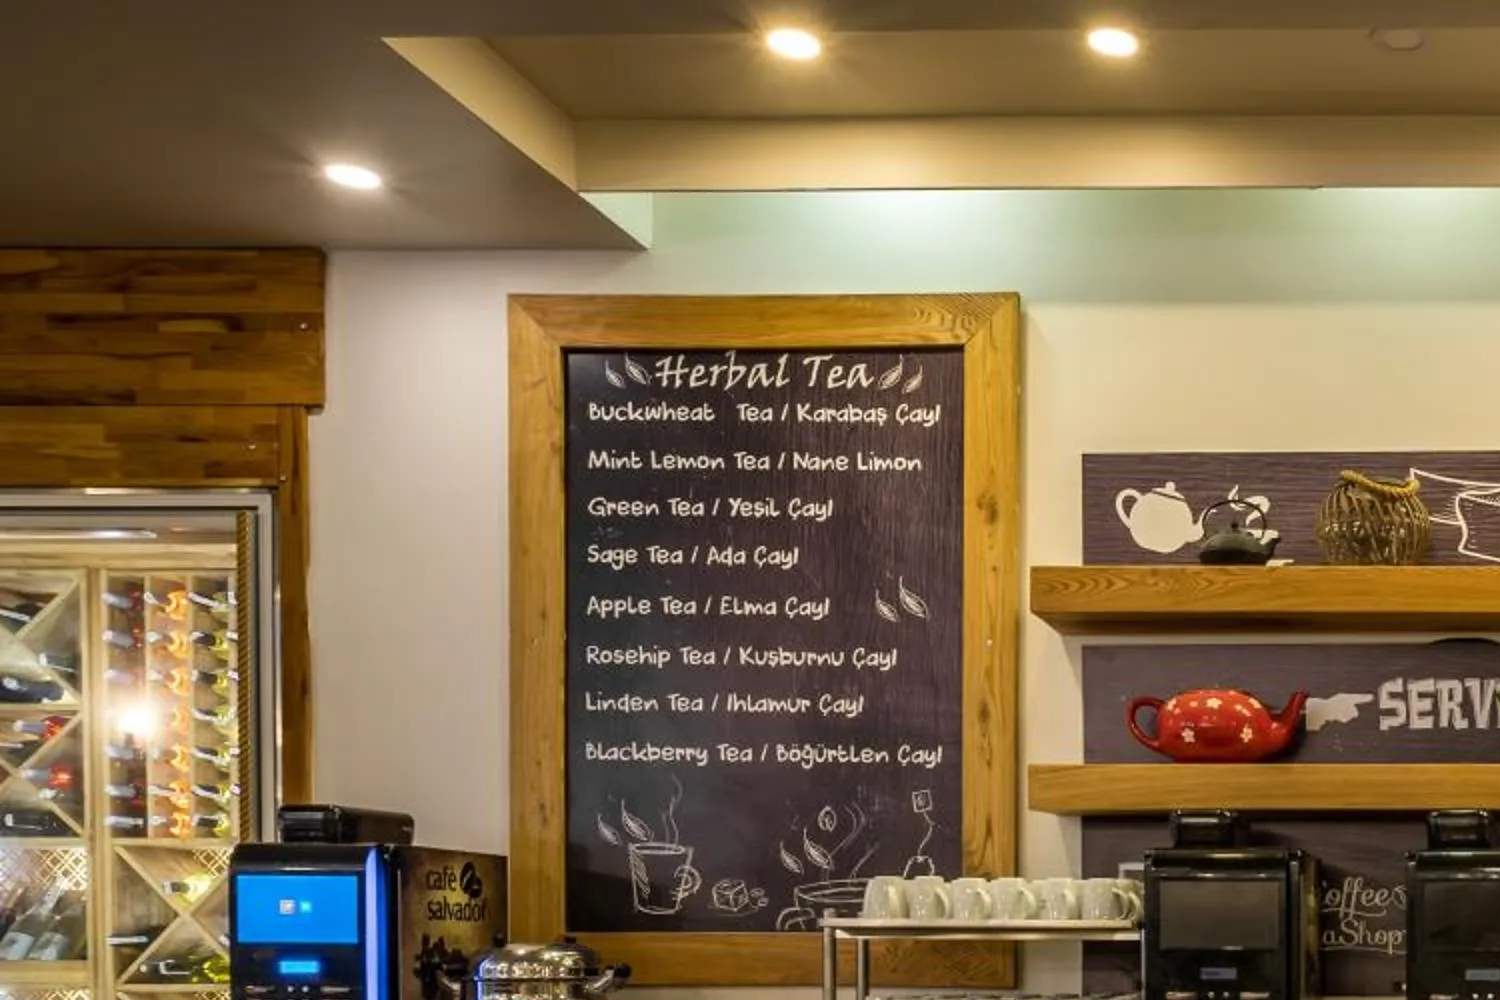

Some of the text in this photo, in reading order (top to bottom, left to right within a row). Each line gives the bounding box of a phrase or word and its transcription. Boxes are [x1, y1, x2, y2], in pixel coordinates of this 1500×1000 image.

[655, 351, 875, 391] Herbal Tea
[588, 401, 716, 422] Buckwheat
[736, 403, 774, 422] Tea
[588, 449, 643, 470] Mint
[650, 450, 725, 470] Lemon
[733, 451, 771, 471] Tea
[793, 451, 849, 471] Nane
[857, 451, 922, 471] Limon
[587, 496, 660, 517] Green
[667, 497, 705, 517] Tea
[587, 544, 639, 571] Sage
[646, 545, 683, 565] Tea
[706, 545, 747, 567] Ada
[586, 595, 652, 619] Apple
[659, 595, 697, 615] Tea
[719, 595, 777, 616] Elma
[586, 645, 671, 669] Rosehip
[679, 646, 716, 665] Tea
[585, 692, 659, 713] Linden
[667, 693, 704, 713] Tea
[585, 741, 709, 767] Blackberry
[716, 743, 753, 763] Tea
[1322, 877, 1391, 919] offee
